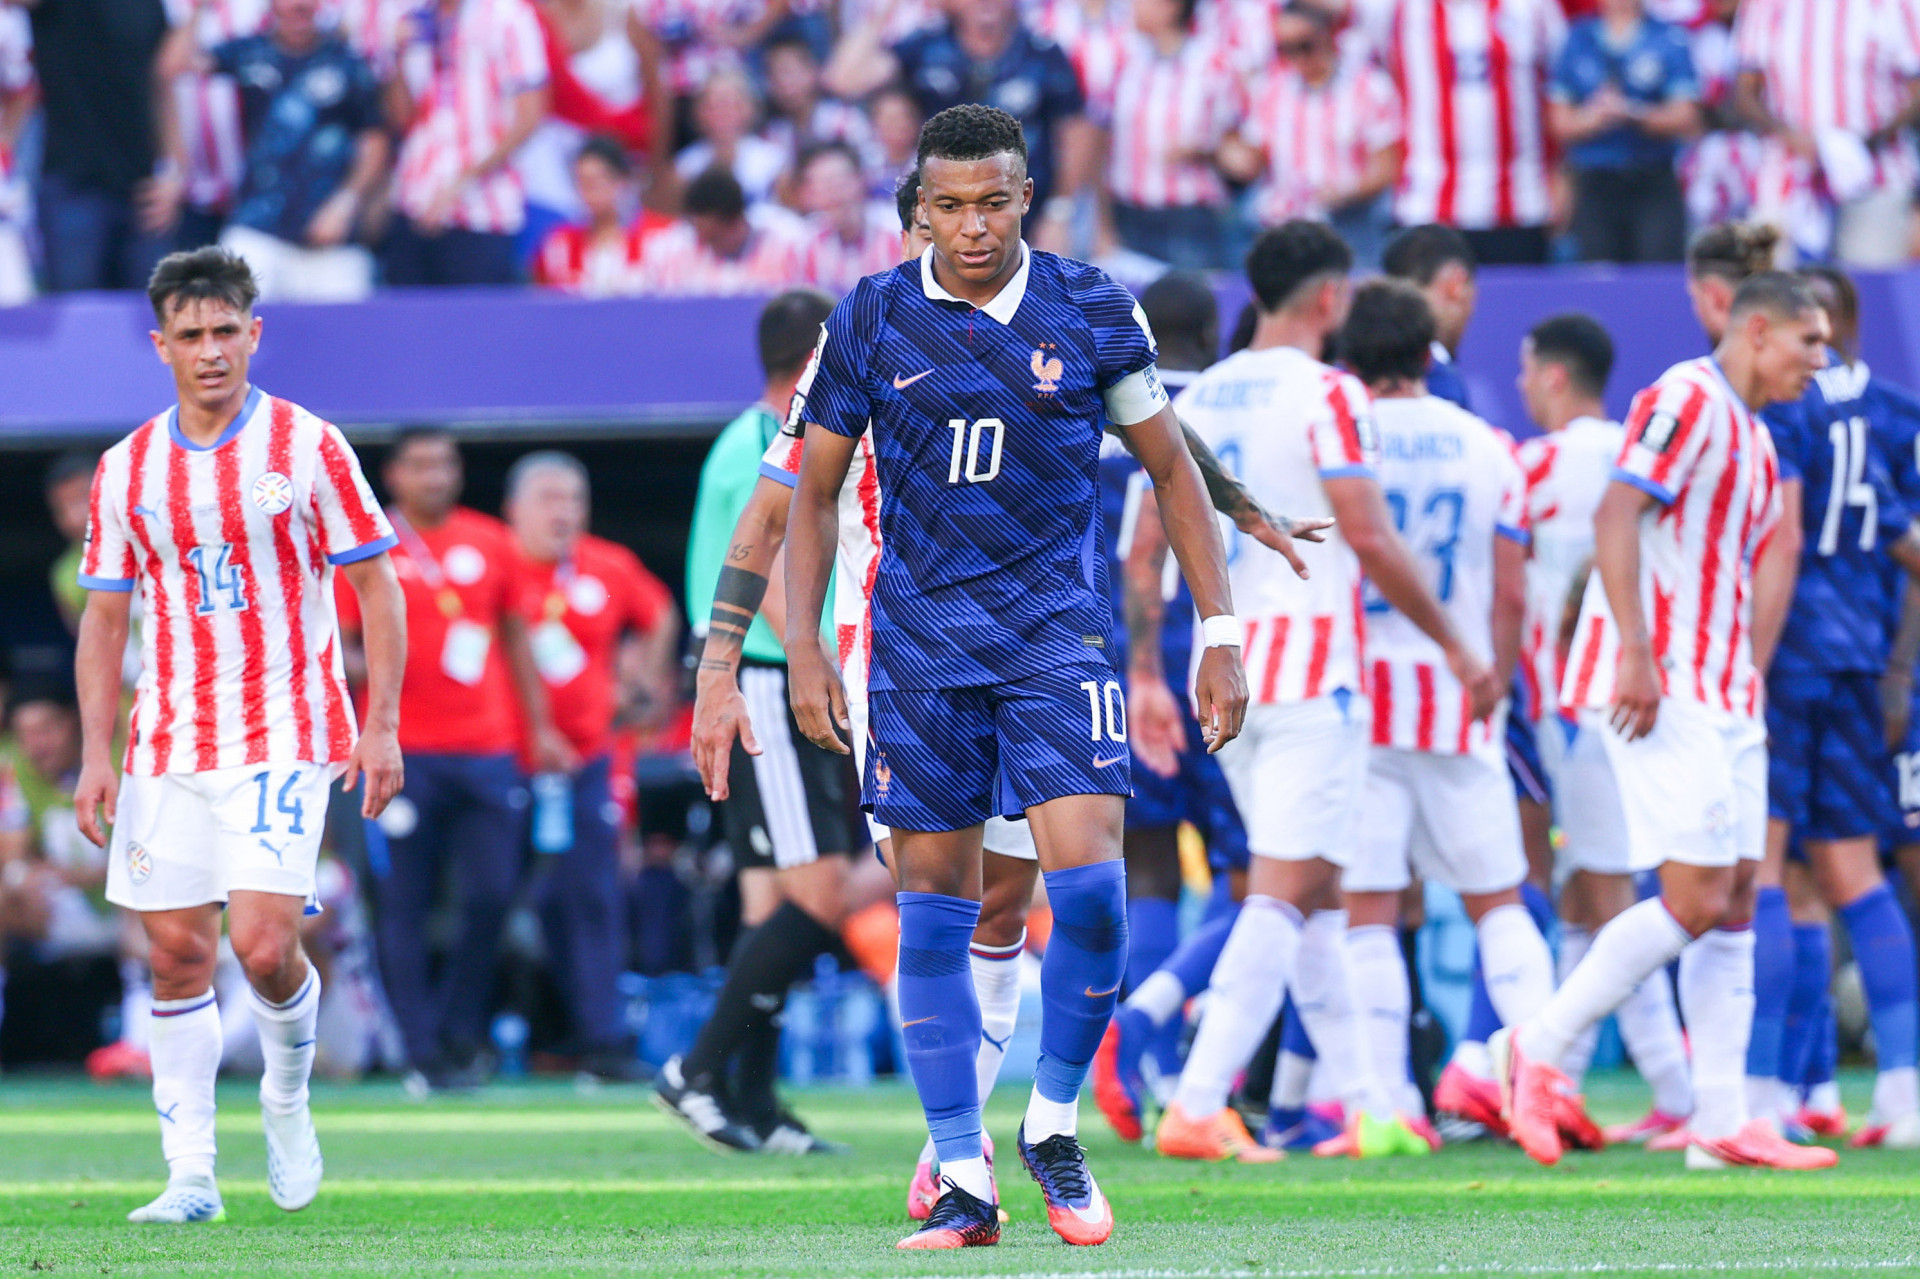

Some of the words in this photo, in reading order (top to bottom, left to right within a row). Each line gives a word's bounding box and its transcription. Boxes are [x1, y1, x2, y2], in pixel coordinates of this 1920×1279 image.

[948, 418, 1005, 483] 10
[1817, 416, 1879, 557] 14
[186, 543, 249, 615] 14
[1080, 680, 1127, 743] 10
[250, 770, 305, 835] 14
